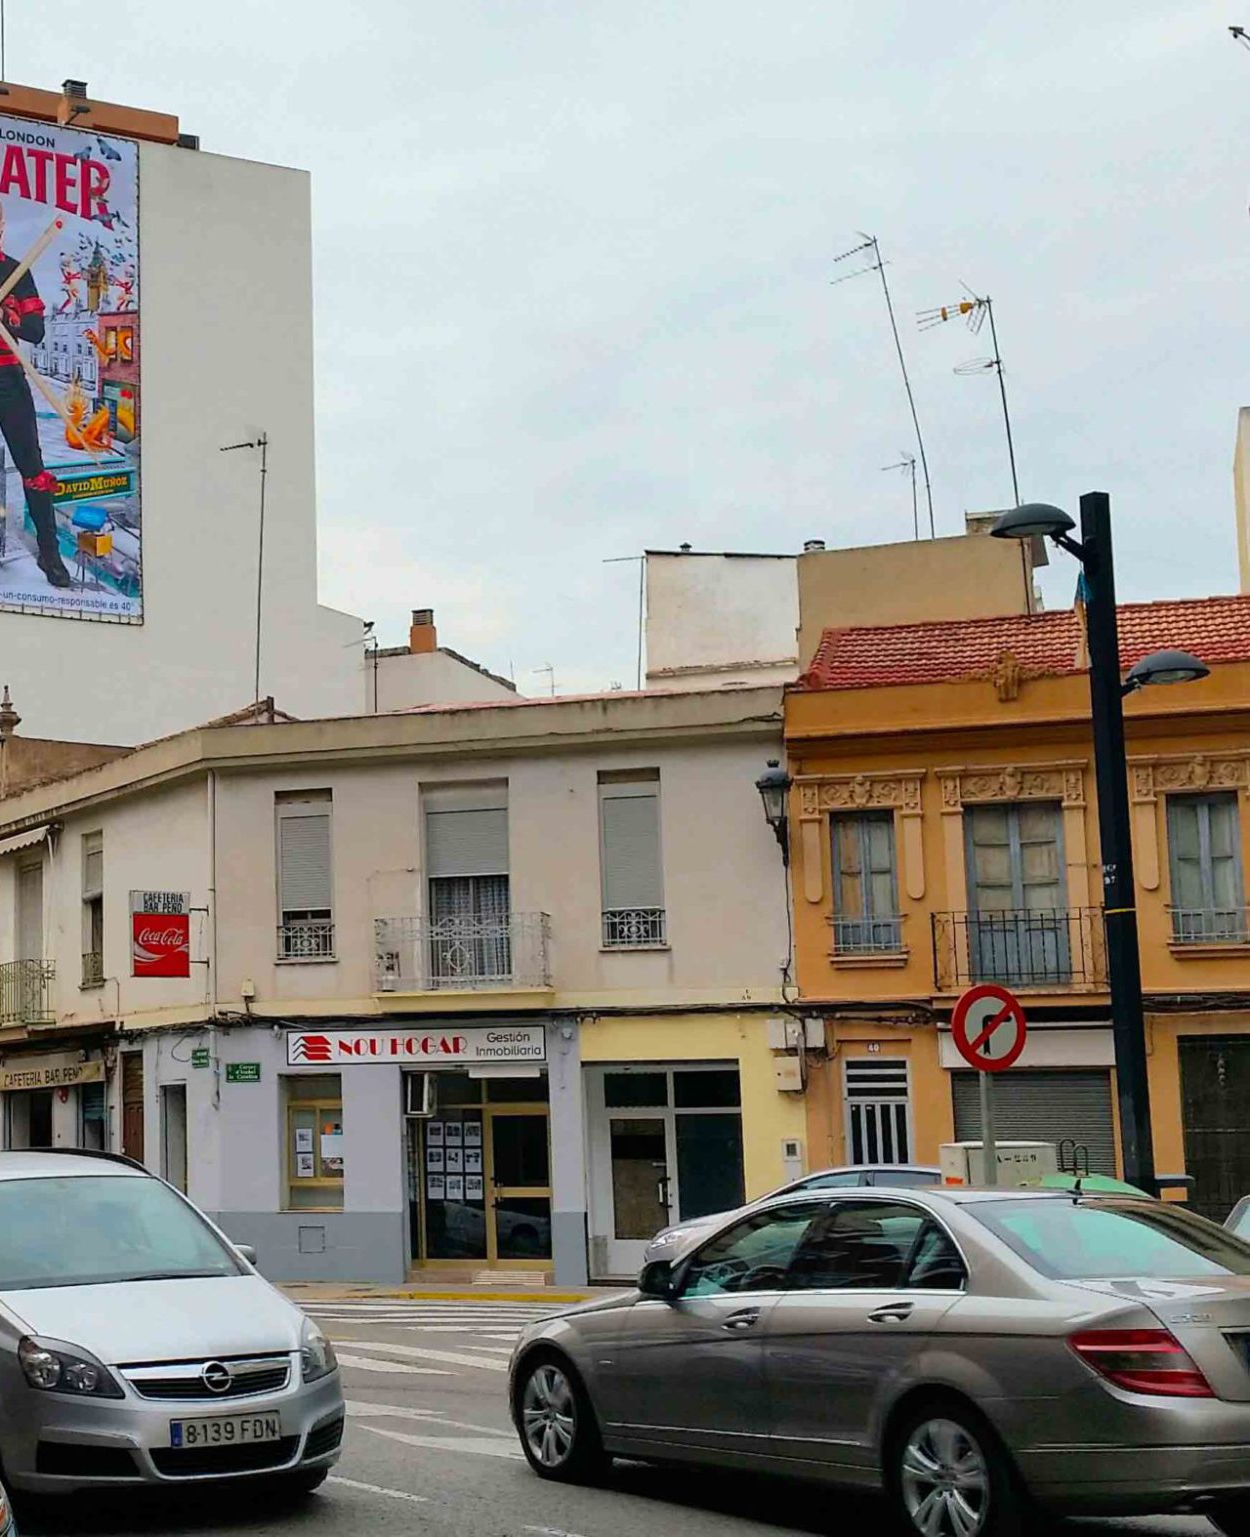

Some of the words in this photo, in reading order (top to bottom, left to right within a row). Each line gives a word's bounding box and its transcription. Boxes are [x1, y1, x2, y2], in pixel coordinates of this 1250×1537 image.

[143, 892, 184, 904] CAFETERIA
[143, 902, 159, 912] BAR
[486, 1031, 530, 1044] Gestión
[338, 1037, 385, 1057] NOU
[390, 1035, 468, 1056] HOGAR
[476, 1044, 542, 1057] Inmobiliaria
[4, 1071, 42, 1088] CAFETERIA
[186, 1421, 235, 1444] 8139
[241, 1418, 278, 1439] FDN
